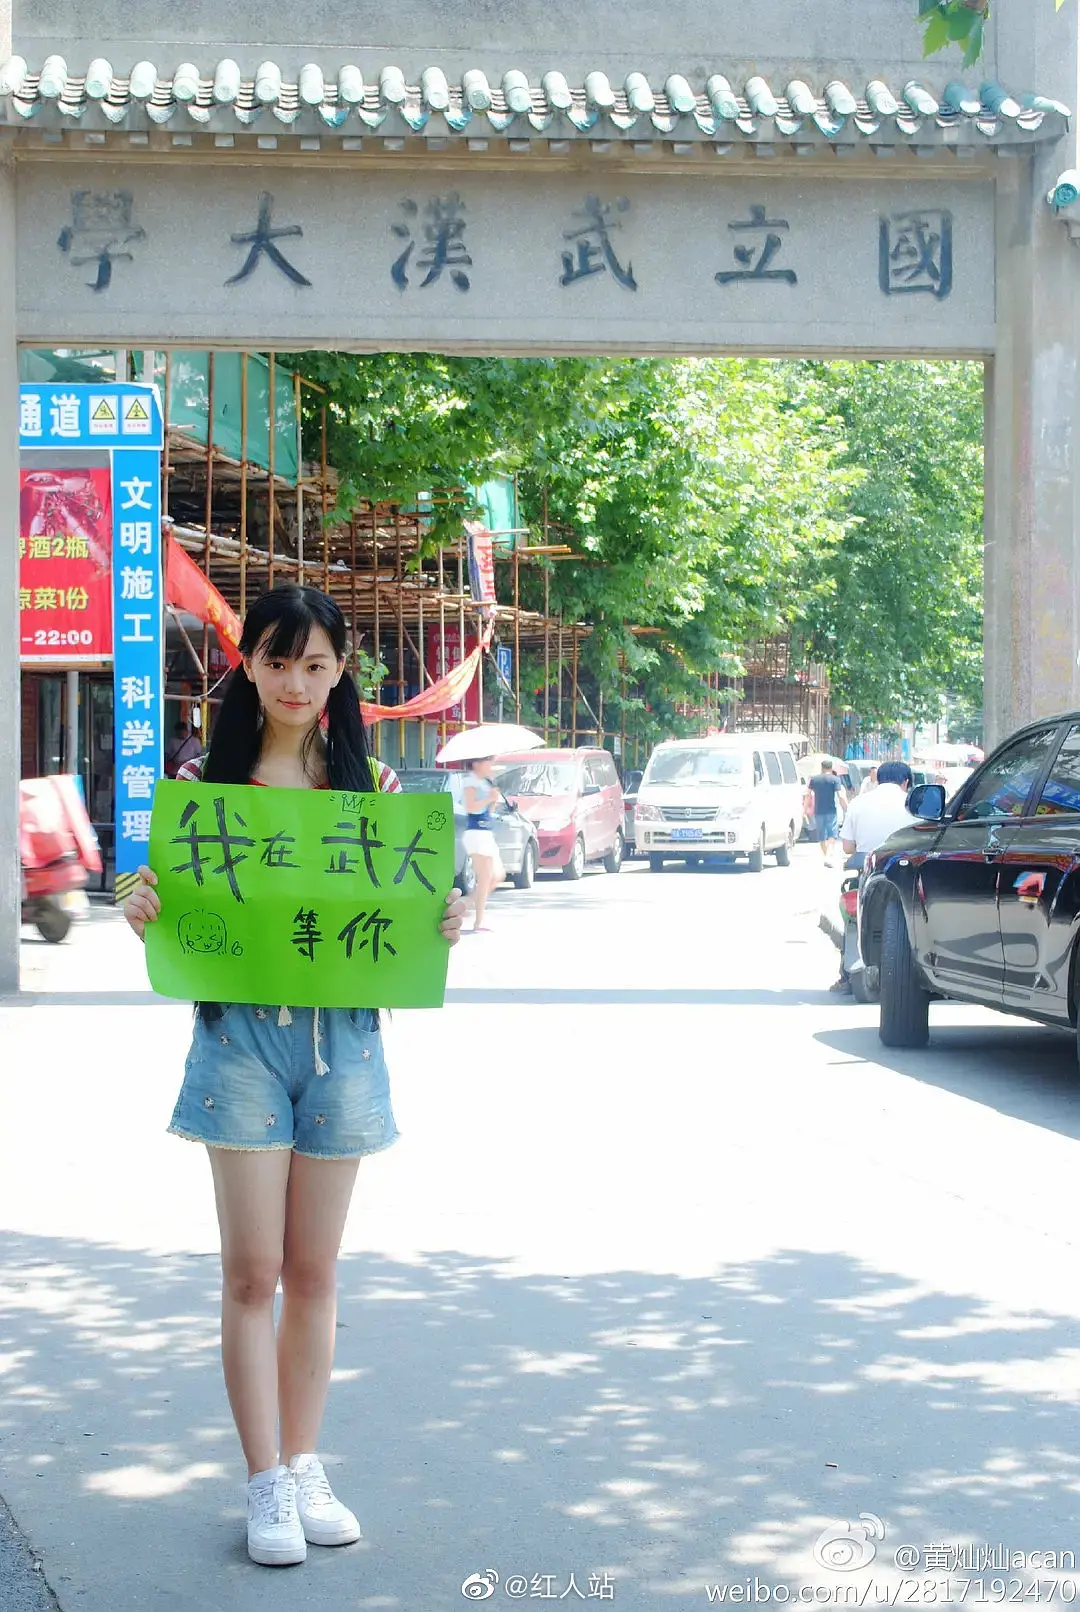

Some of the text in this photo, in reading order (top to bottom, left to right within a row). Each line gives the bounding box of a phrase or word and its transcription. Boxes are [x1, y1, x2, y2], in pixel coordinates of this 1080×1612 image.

[19, 393, 81, 437] 通道
[120, 477, 154, 642] 文明施工
[121, 675, 155, 842] 科学管理
[169, 797, 437, 904] 我在武大
[291, 906, 398, 963] 等你
